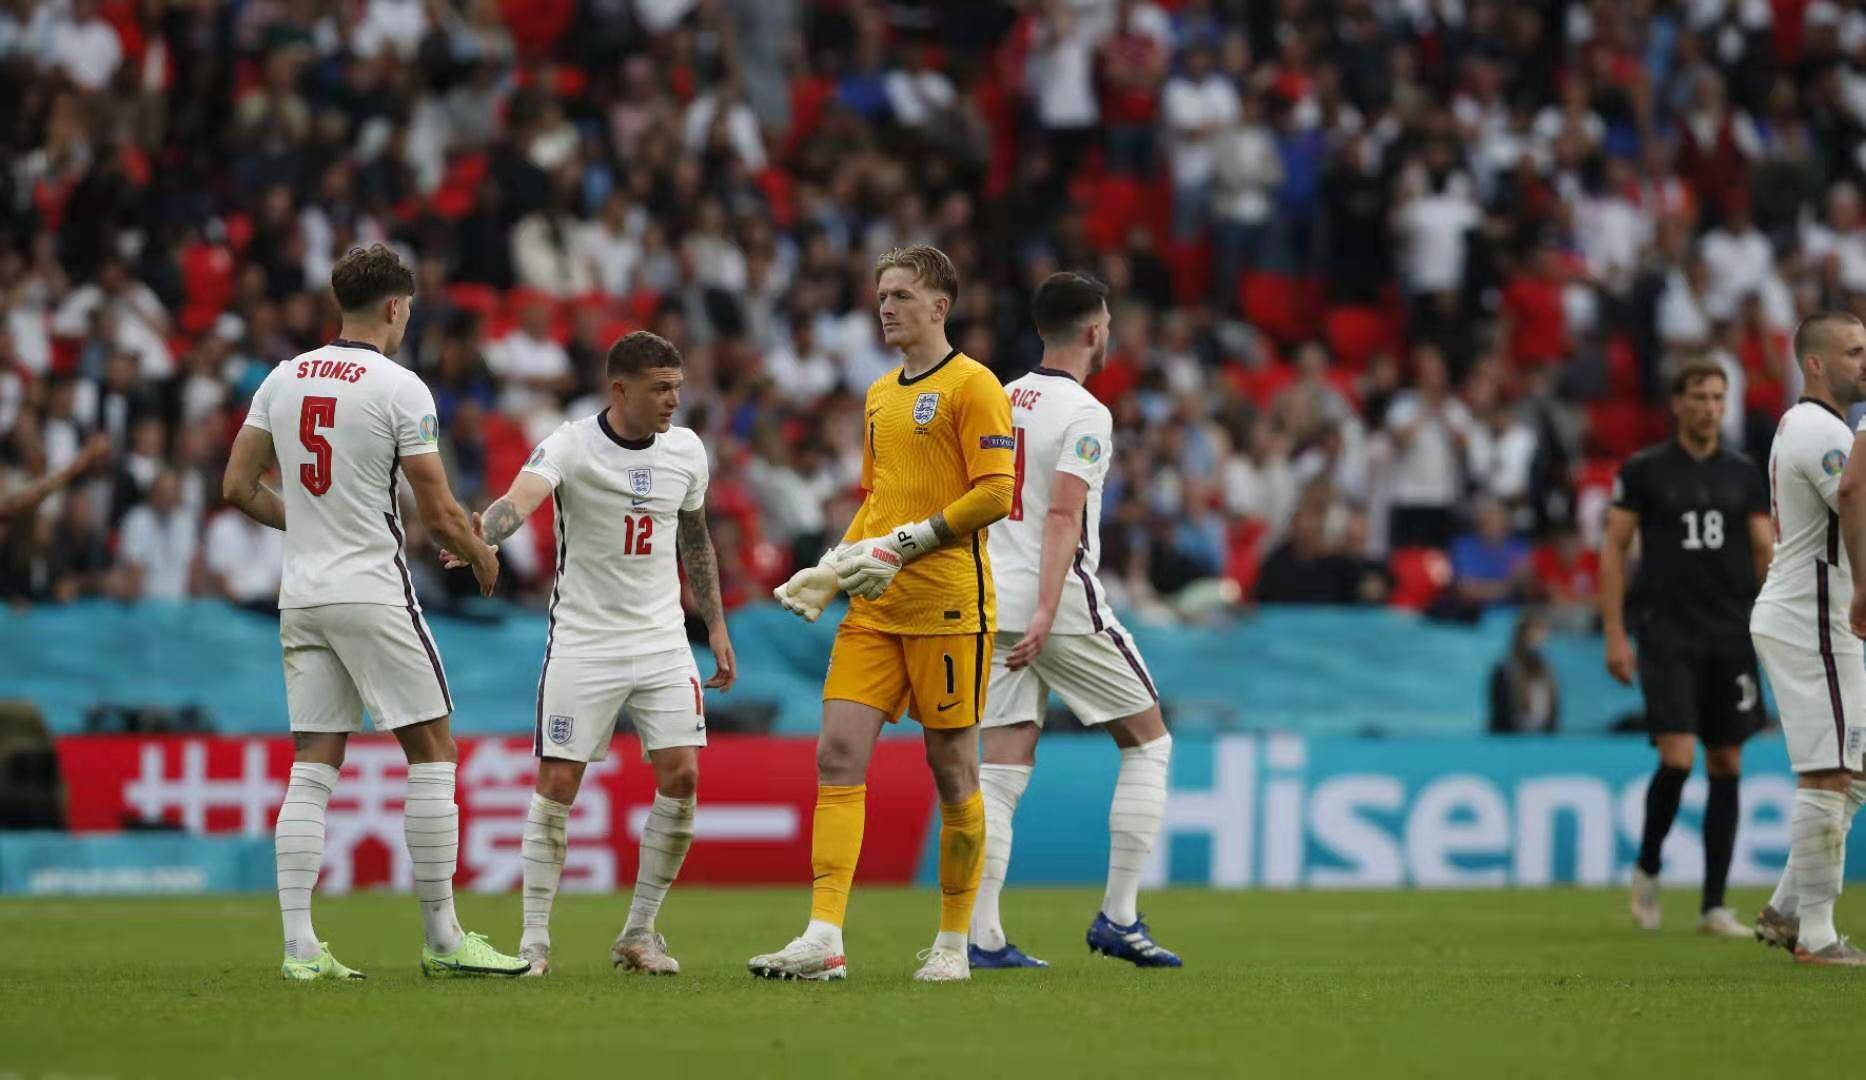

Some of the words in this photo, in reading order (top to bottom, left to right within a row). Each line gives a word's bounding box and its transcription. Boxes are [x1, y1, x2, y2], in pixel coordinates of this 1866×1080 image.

[297, 360, 367, 384] STONES
[1011, 388, 1041, 411] RICE
[300, 396, 337, 496] 5
[624, 515, 652, 555] 12
[897, 531, 917, 549] JP
[1681, 510, 1724, 549] 18
[943, 653, 954, 695] 1
[1140, 734, 1798, 888] Hisense
